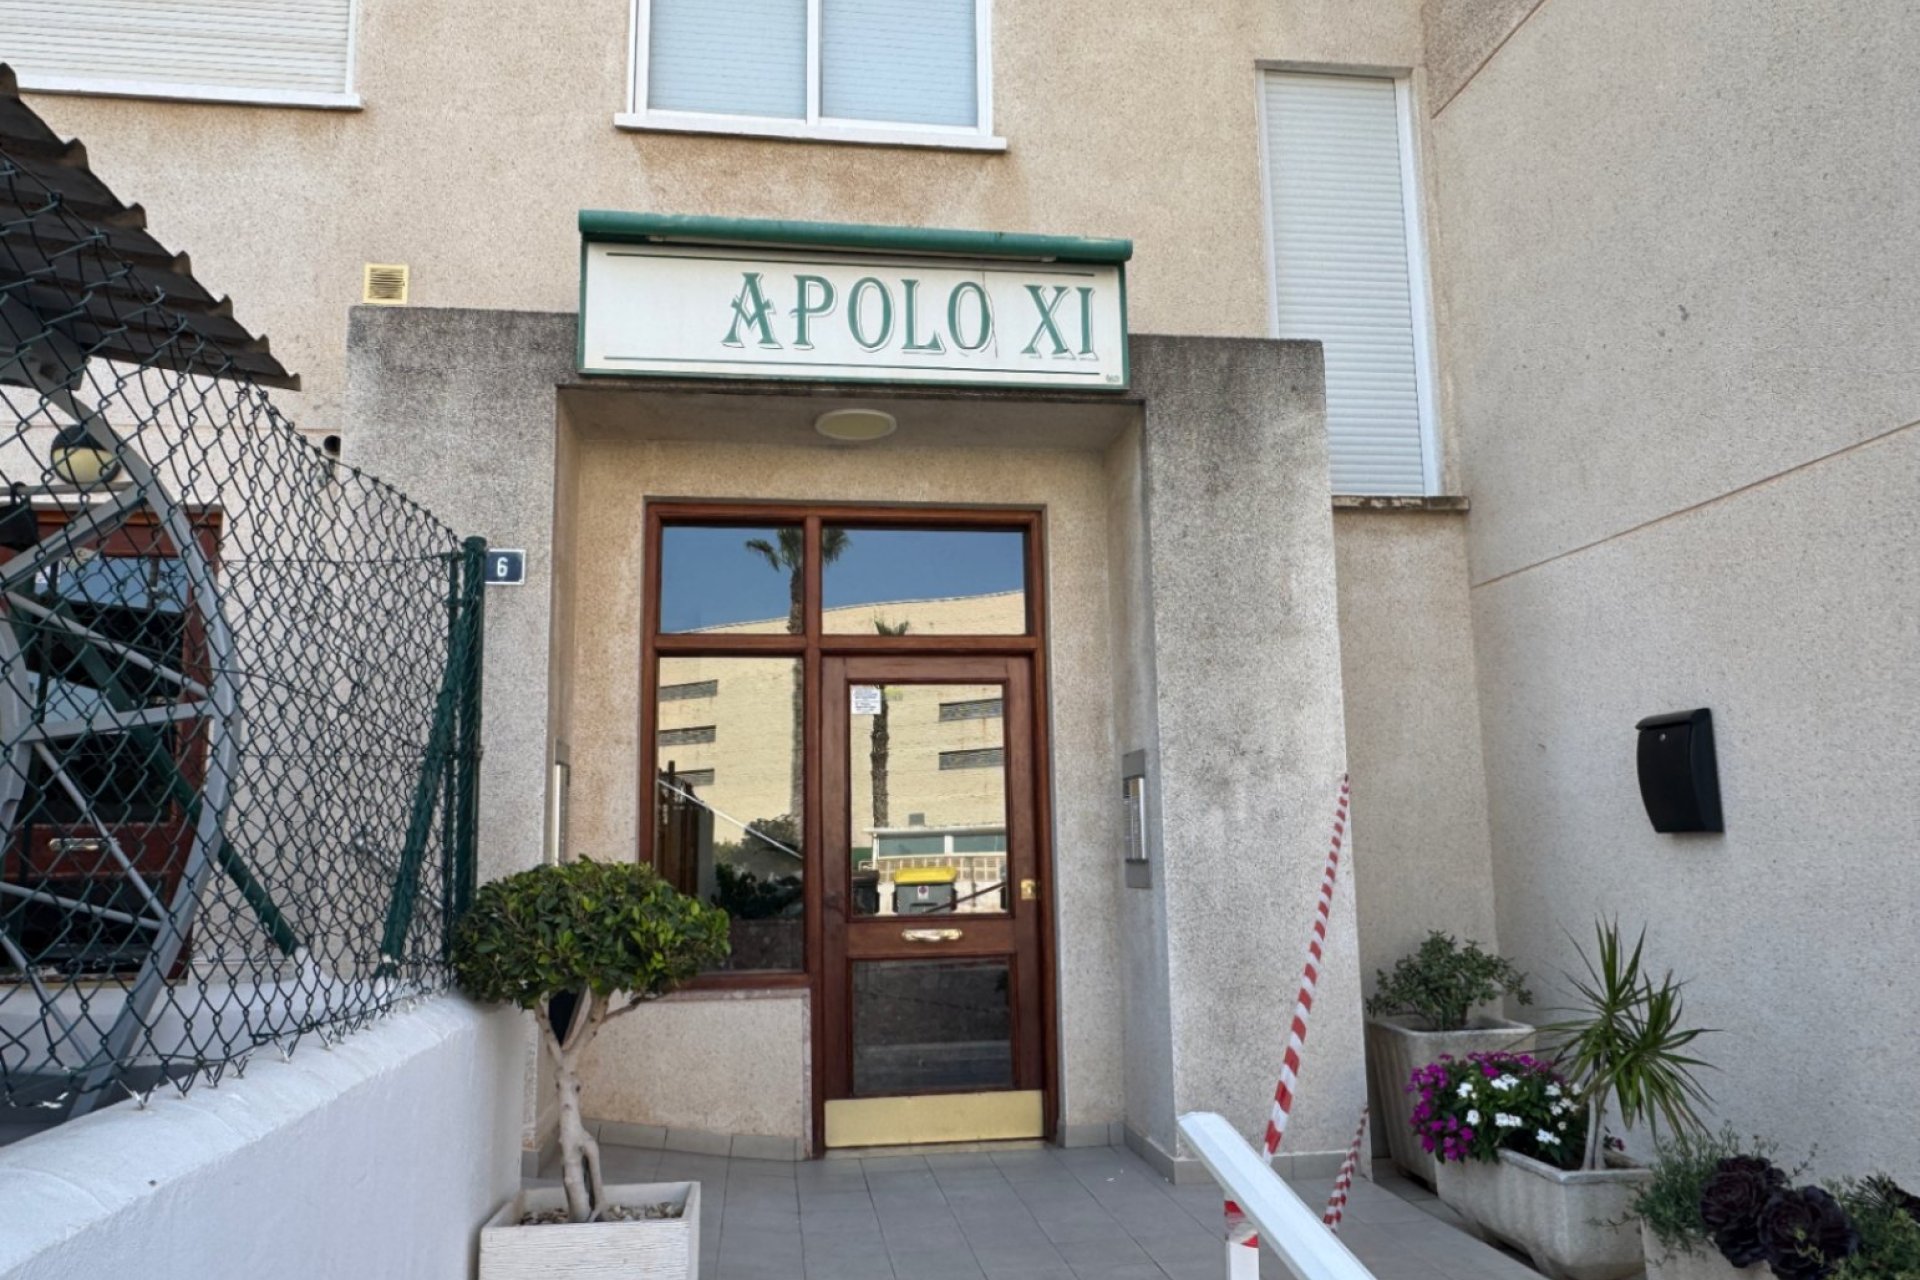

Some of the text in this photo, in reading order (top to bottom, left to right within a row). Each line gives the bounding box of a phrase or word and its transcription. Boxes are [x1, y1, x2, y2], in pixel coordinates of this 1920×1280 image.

[721, 271, 1099, 361] APOLO XI
[497, 556, 508, 577] 6
